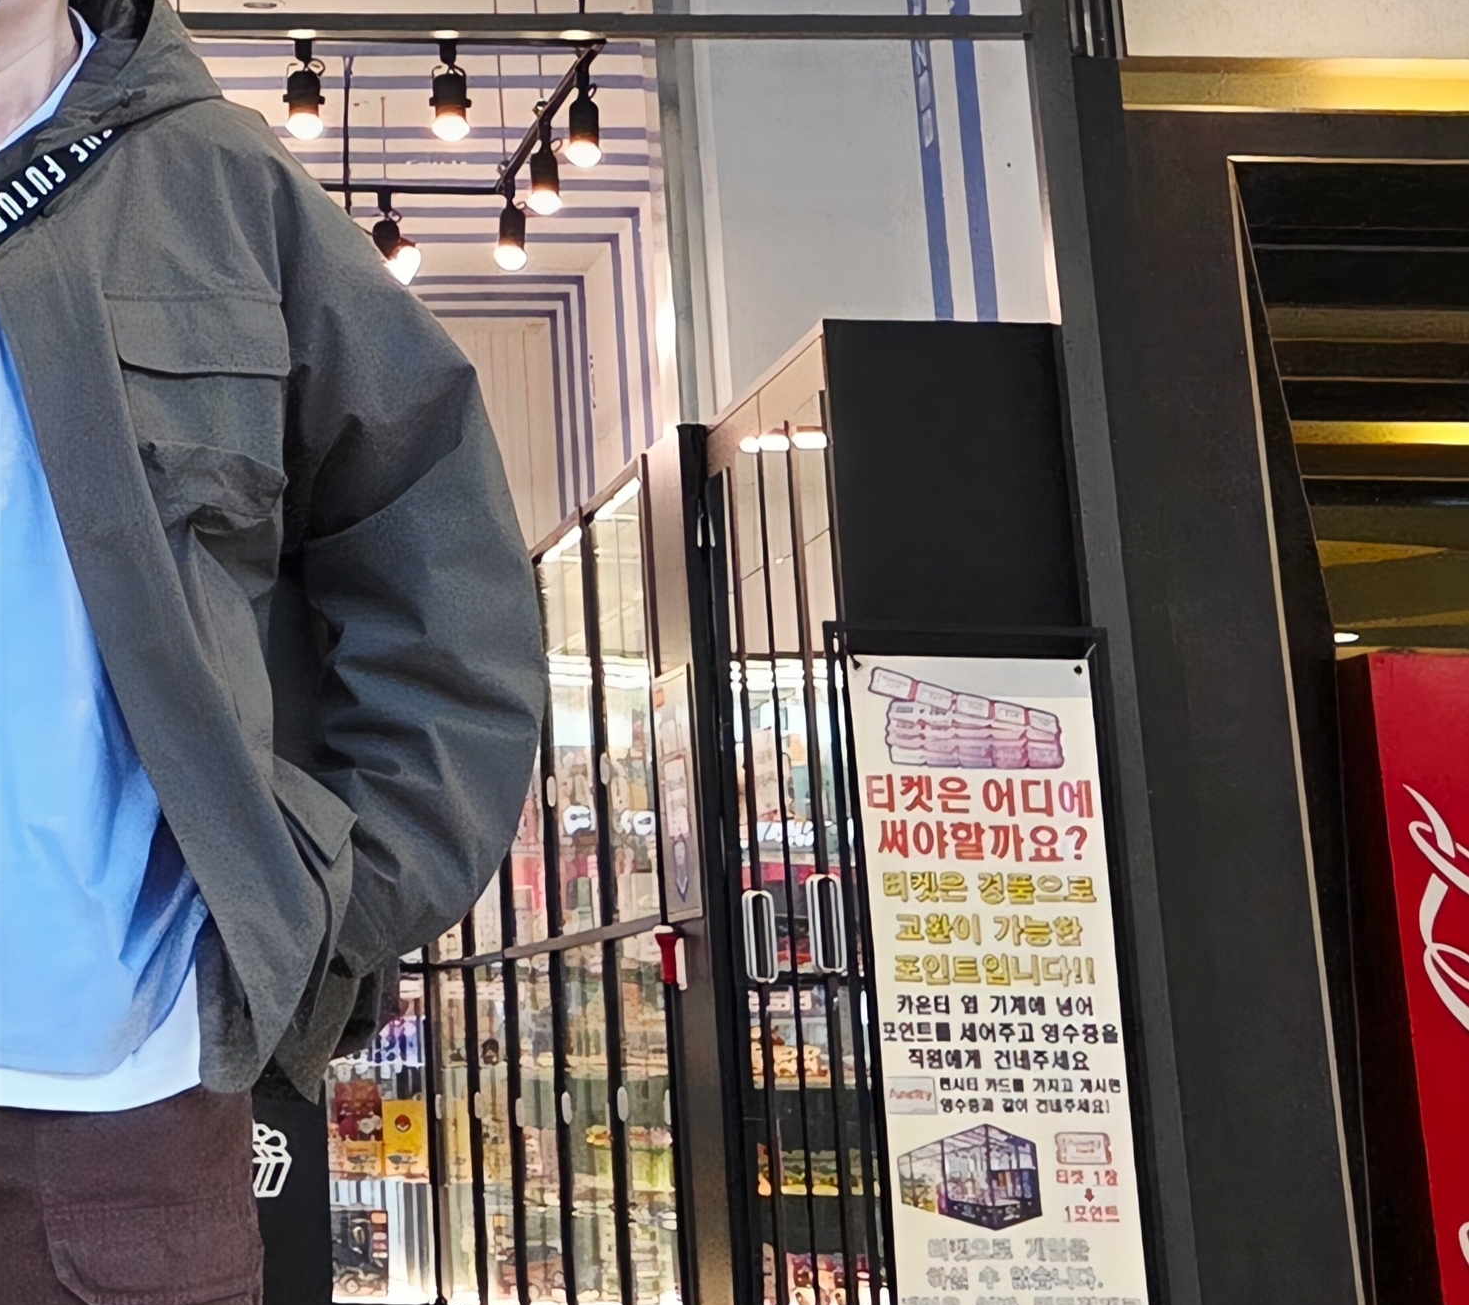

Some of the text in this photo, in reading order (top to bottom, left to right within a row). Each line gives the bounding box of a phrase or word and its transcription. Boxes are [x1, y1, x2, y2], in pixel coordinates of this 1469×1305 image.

[69, 128, 113, 163] HE
[865, 773, 1094, 818] 티켓은 어디에
[878, 818, 1089, 863] 써야할까요?
[882, 870, 1098, 905] 티켓은 경품으로
[895, 912, 1084, 947] 교환이 가능한
[894, 953, 1096, 987] 포인트입니다!!
[990, 995, 1047, 1016] 기계에
[883, 1021, 1119, 1045] 포인트 세어주고 영수증을
[908, 1047, 1090, 1071] 직원에게 건네주세요
[984, 1077, 1025, 1093] 카드
